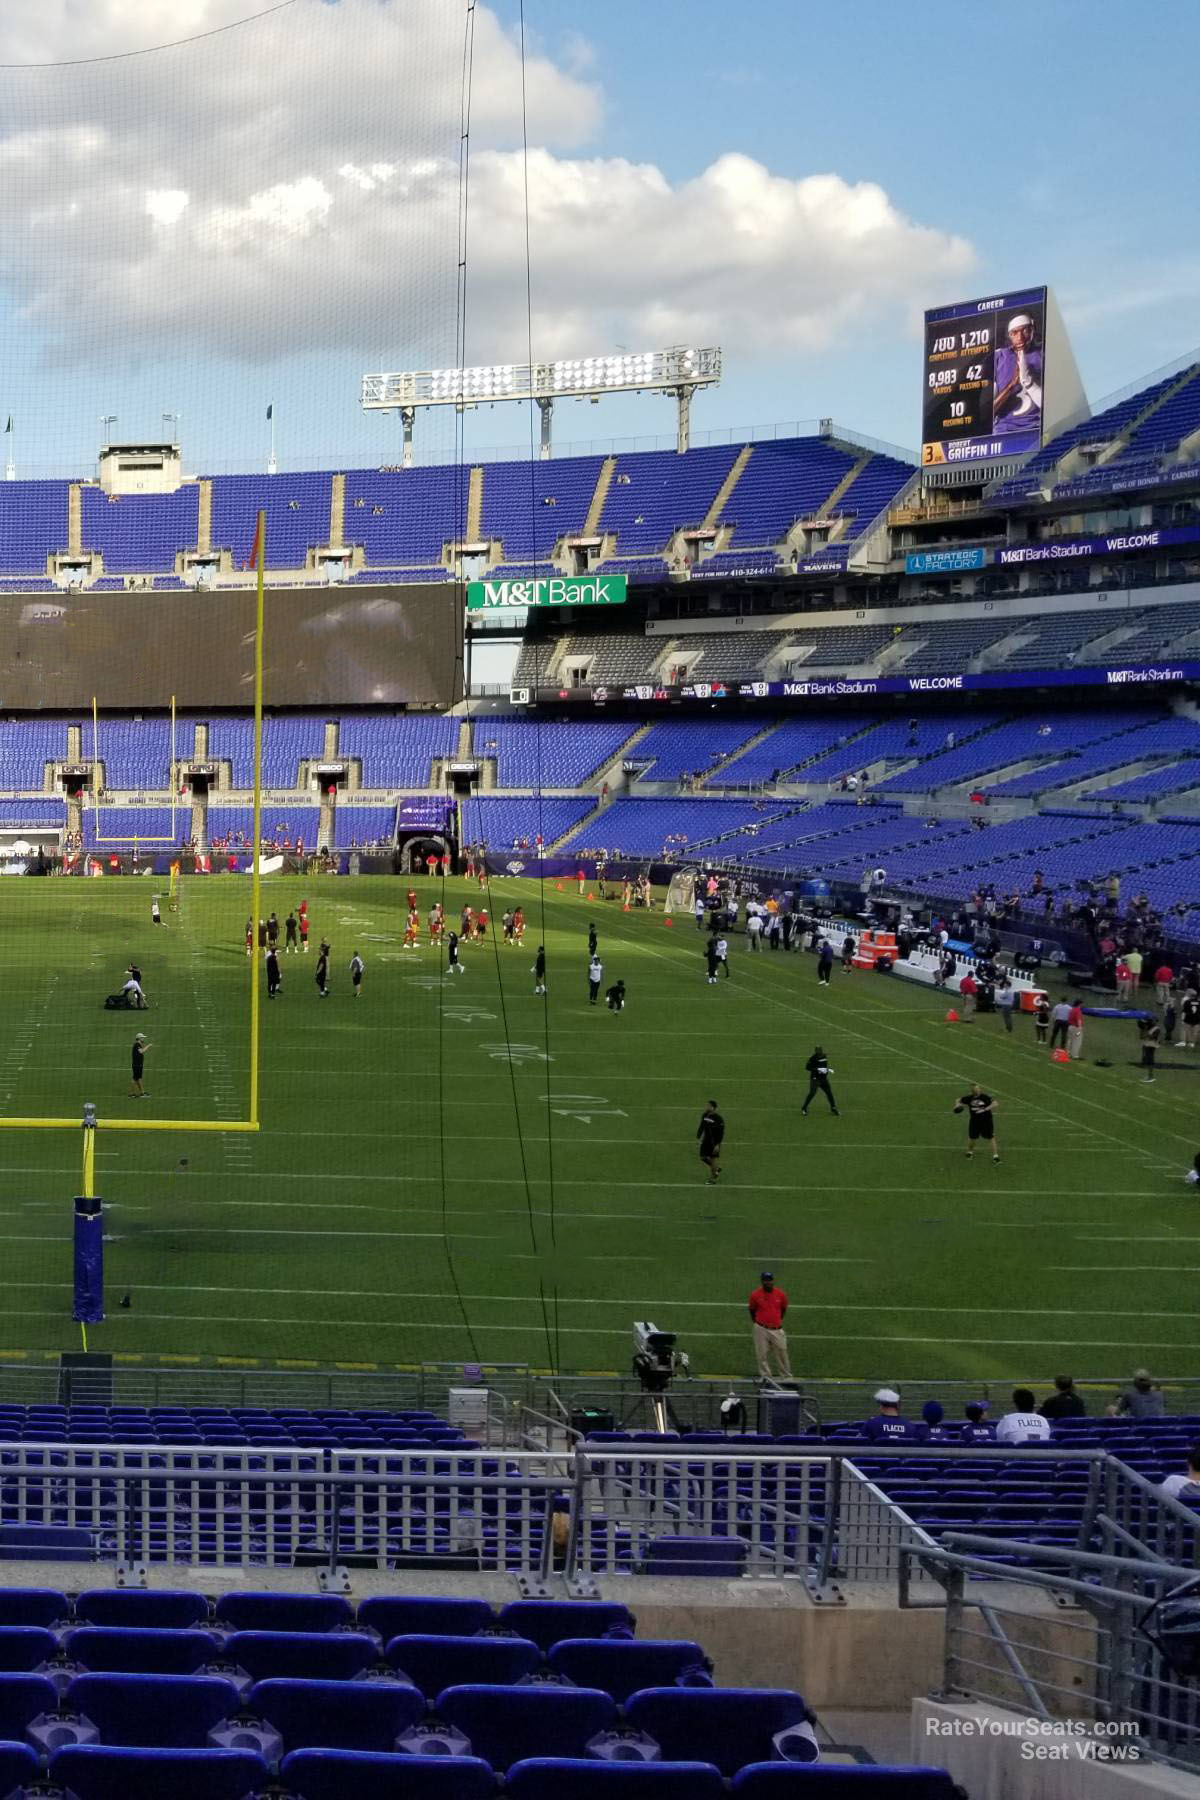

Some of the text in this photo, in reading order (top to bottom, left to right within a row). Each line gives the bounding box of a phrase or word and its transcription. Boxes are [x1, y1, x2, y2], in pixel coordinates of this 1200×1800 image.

[977, 299, 1004, 312] CAREER
[960, 329, 990, 349] 1,210
[960, 345, 990, 357] ATTEMPTS
[928, 365, 982, 388] 8,983 42
[950, 401, 965, 417] 10
[925, 446, 934, 463] 3
[948, 445, 988, 461] GRIFFIN
[990, 442, 1002, 455] III
[1001, 531, 1160, 563] M&T Bank Stadium WELCOME
[926, 550, 978, 562] STRATEGIC
[803, 564, 842, 572] RAVENS
[926, 559, 977, 570] FACTORY
[482, 578, 610, 607] M&T Bank
[1107, 670, 1128, 683] M&T
[784, 677, 962, 695] M&T Bank Stadium WELCOME
[883, 1424, 905, 1433] FLACCO
[1018, 1419, 1042, 1428] FLACCO
